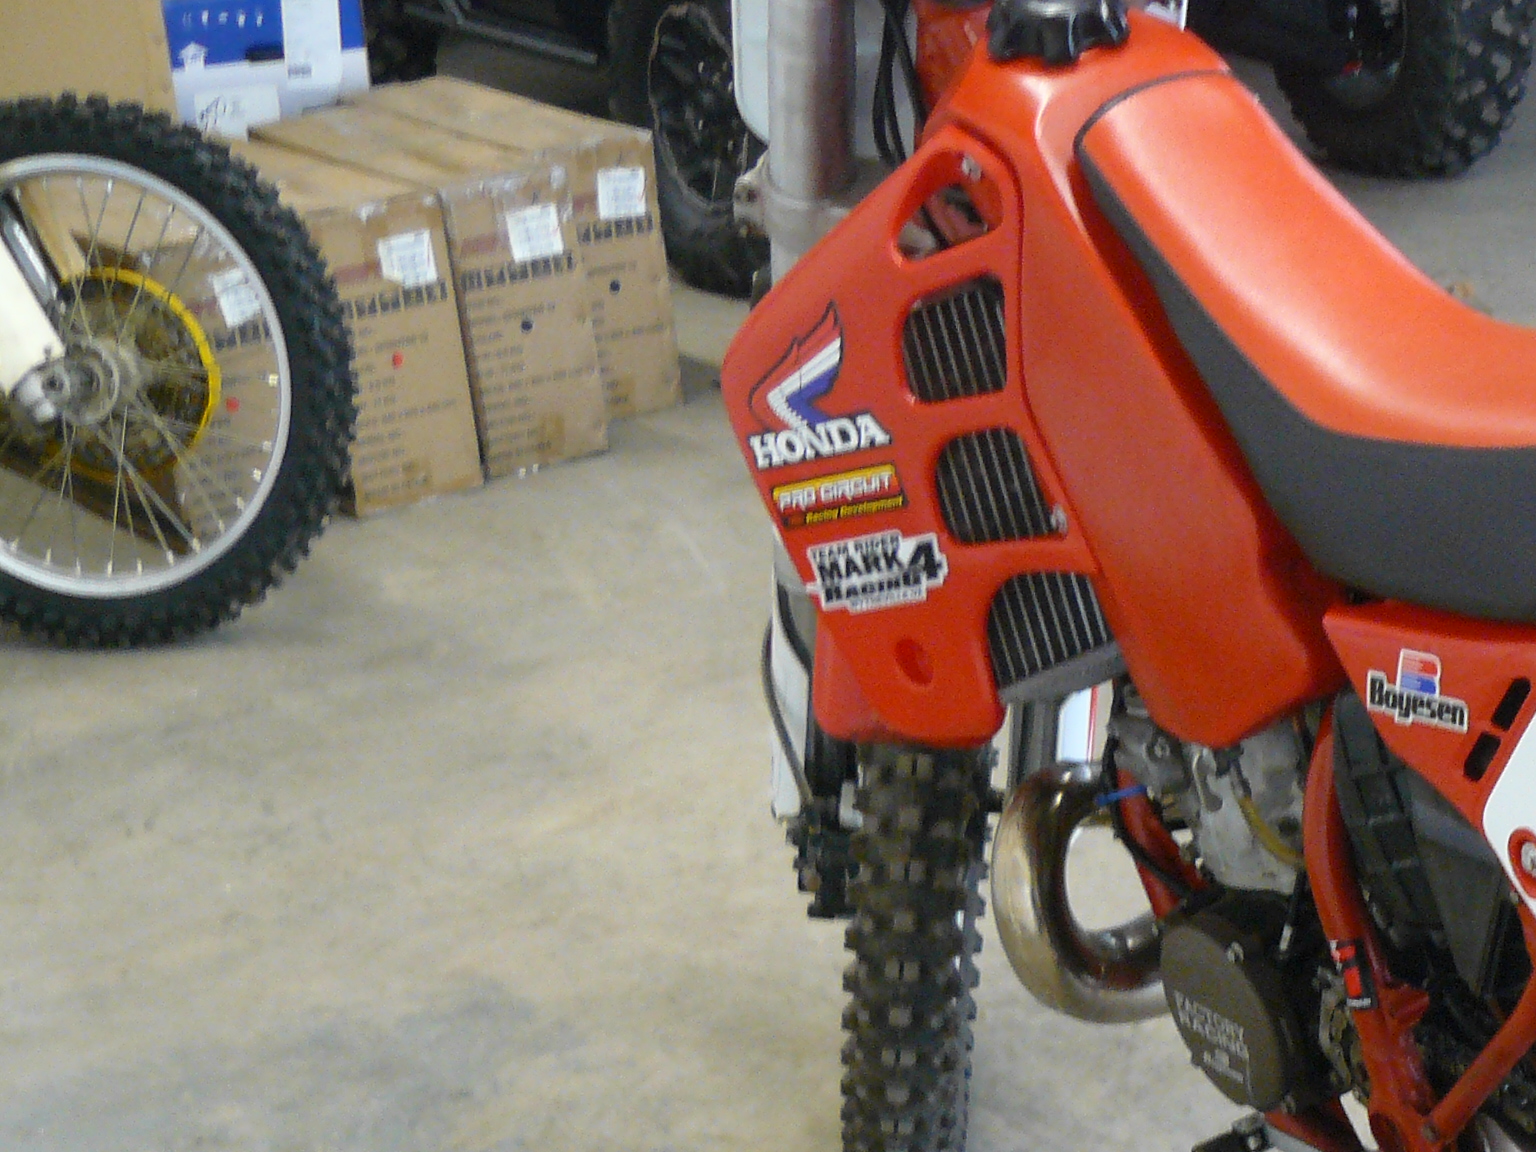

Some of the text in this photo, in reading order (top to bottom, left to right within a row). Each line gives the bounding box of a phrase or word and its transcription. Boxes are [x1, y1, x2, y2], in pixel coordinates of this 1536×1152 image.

[750, 412, 891, 469] HONDA
[779, 473, 892, 511] PRO CIRCUIT
[906, 538, 944, 580] 4
[1369, 676, 1466, 728] Boyesen
